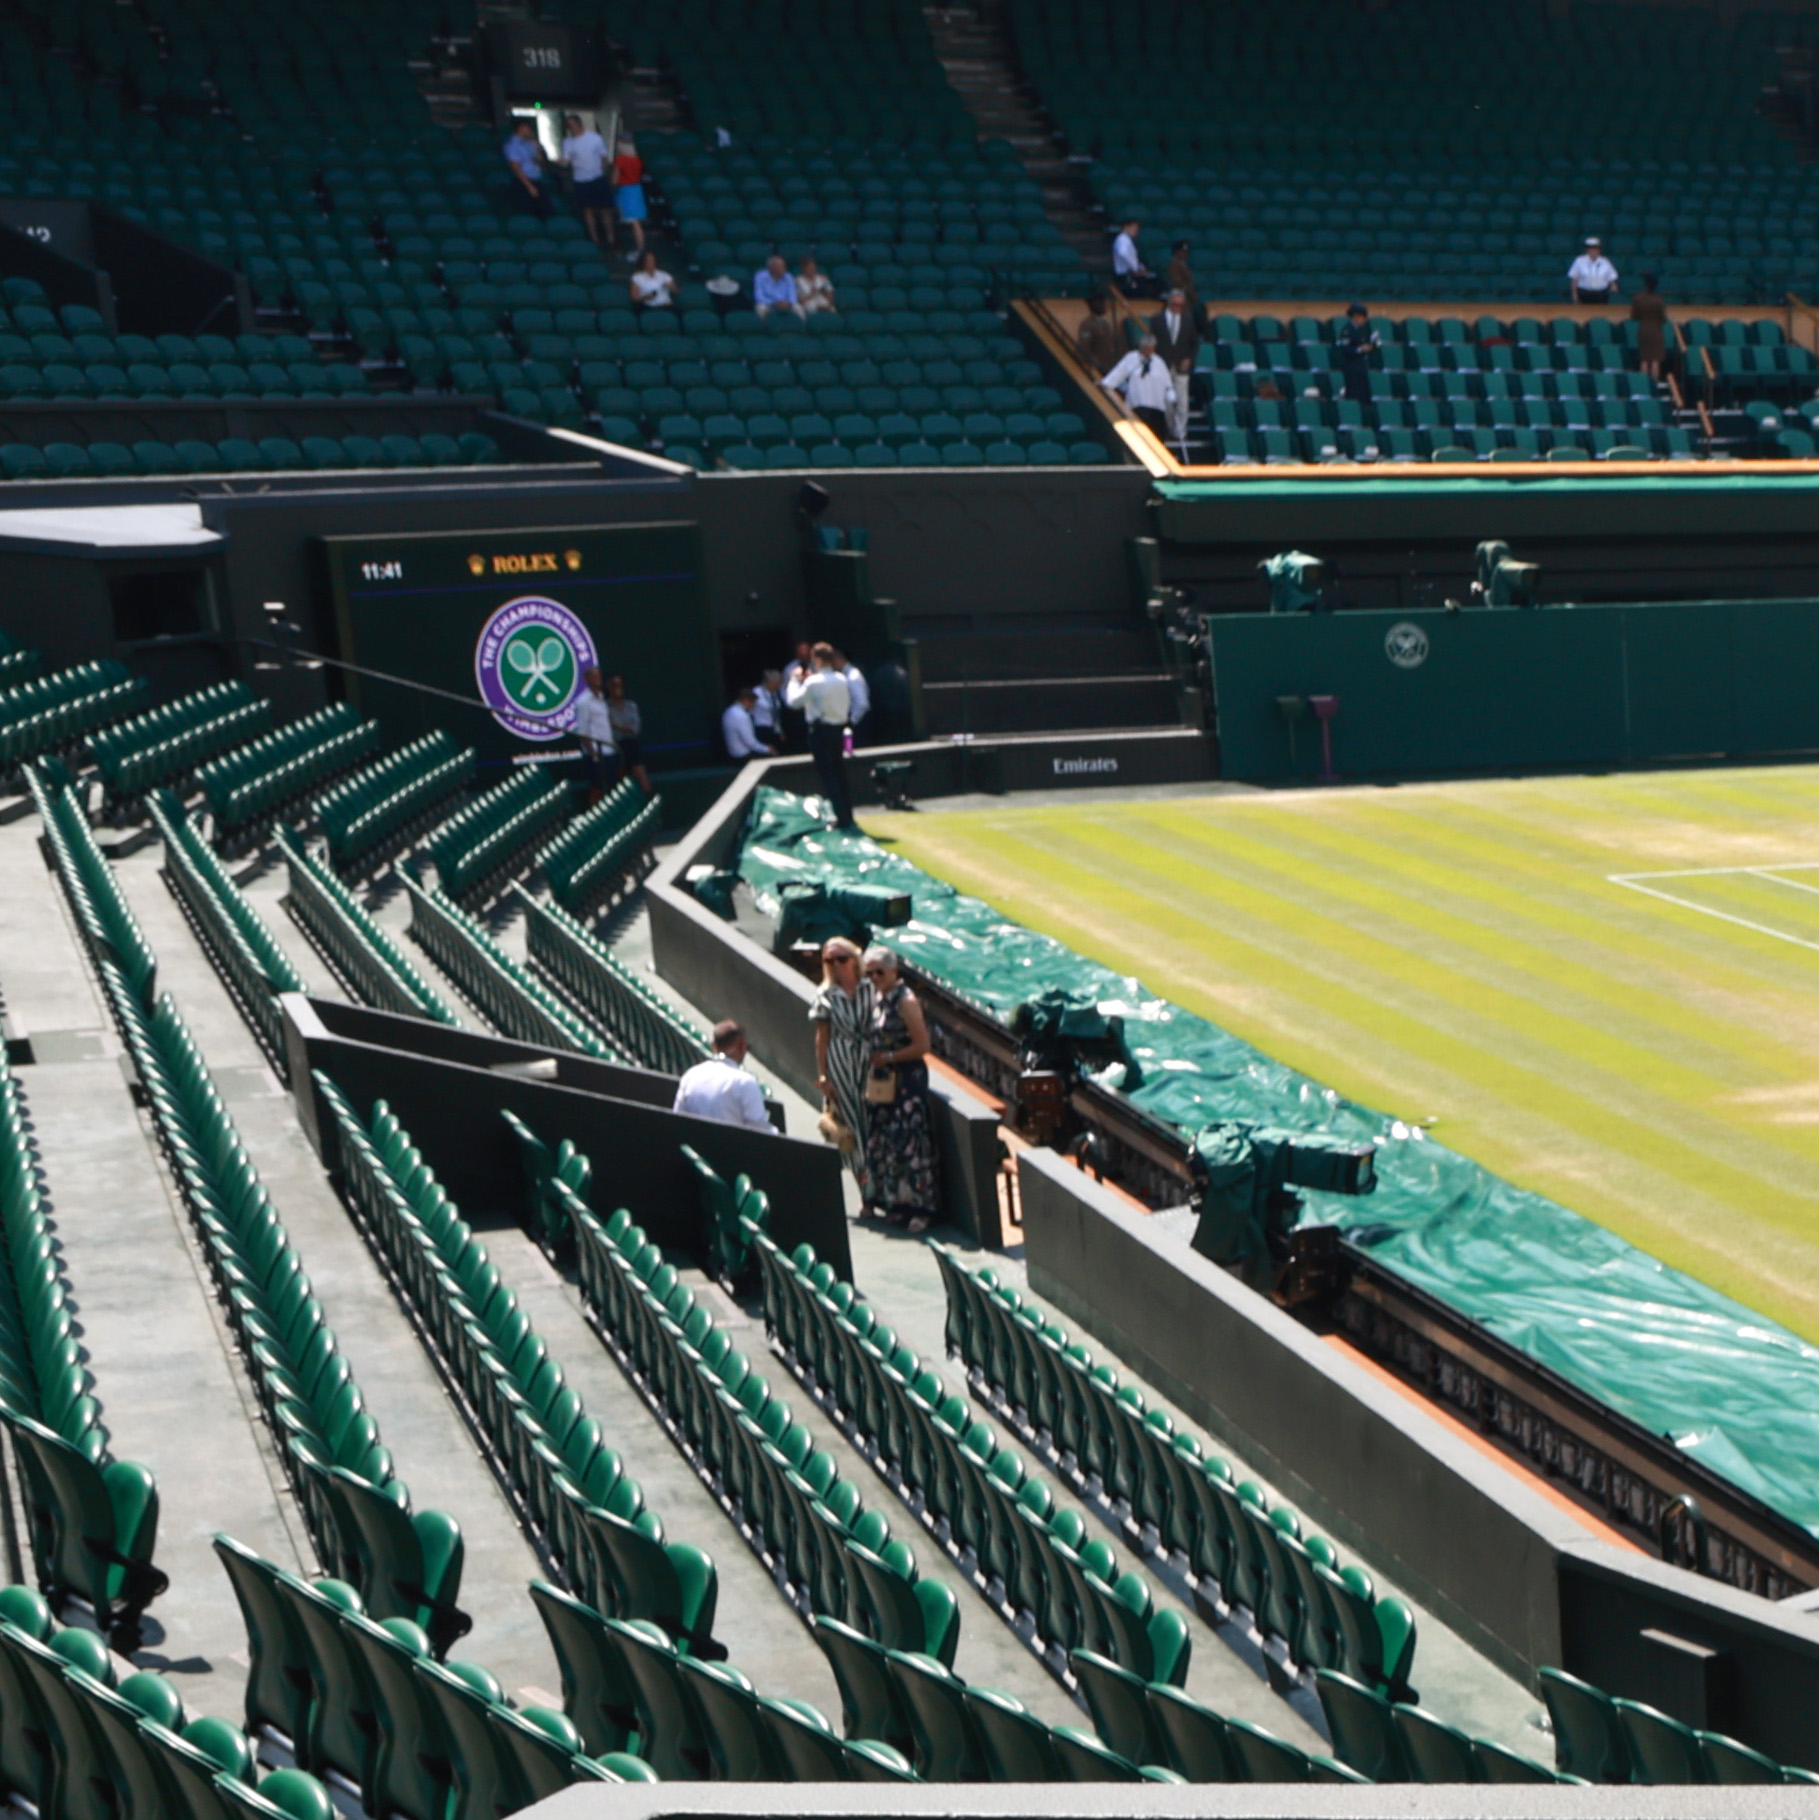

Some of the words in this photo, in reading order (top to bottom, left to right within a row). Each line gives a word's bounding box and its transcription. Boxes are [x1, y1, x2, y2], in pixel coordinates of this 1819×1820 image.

[523, 47, 561, 68] 318
[361, 561, 403, 580] 11:41
[492, 553, 559, 574] ROLEX
[482, 636, 499, 669] THE
[493, 604, 590, 662] CHAMPIONSHIPS
[1053, 757, 1118, 774] Emirates
